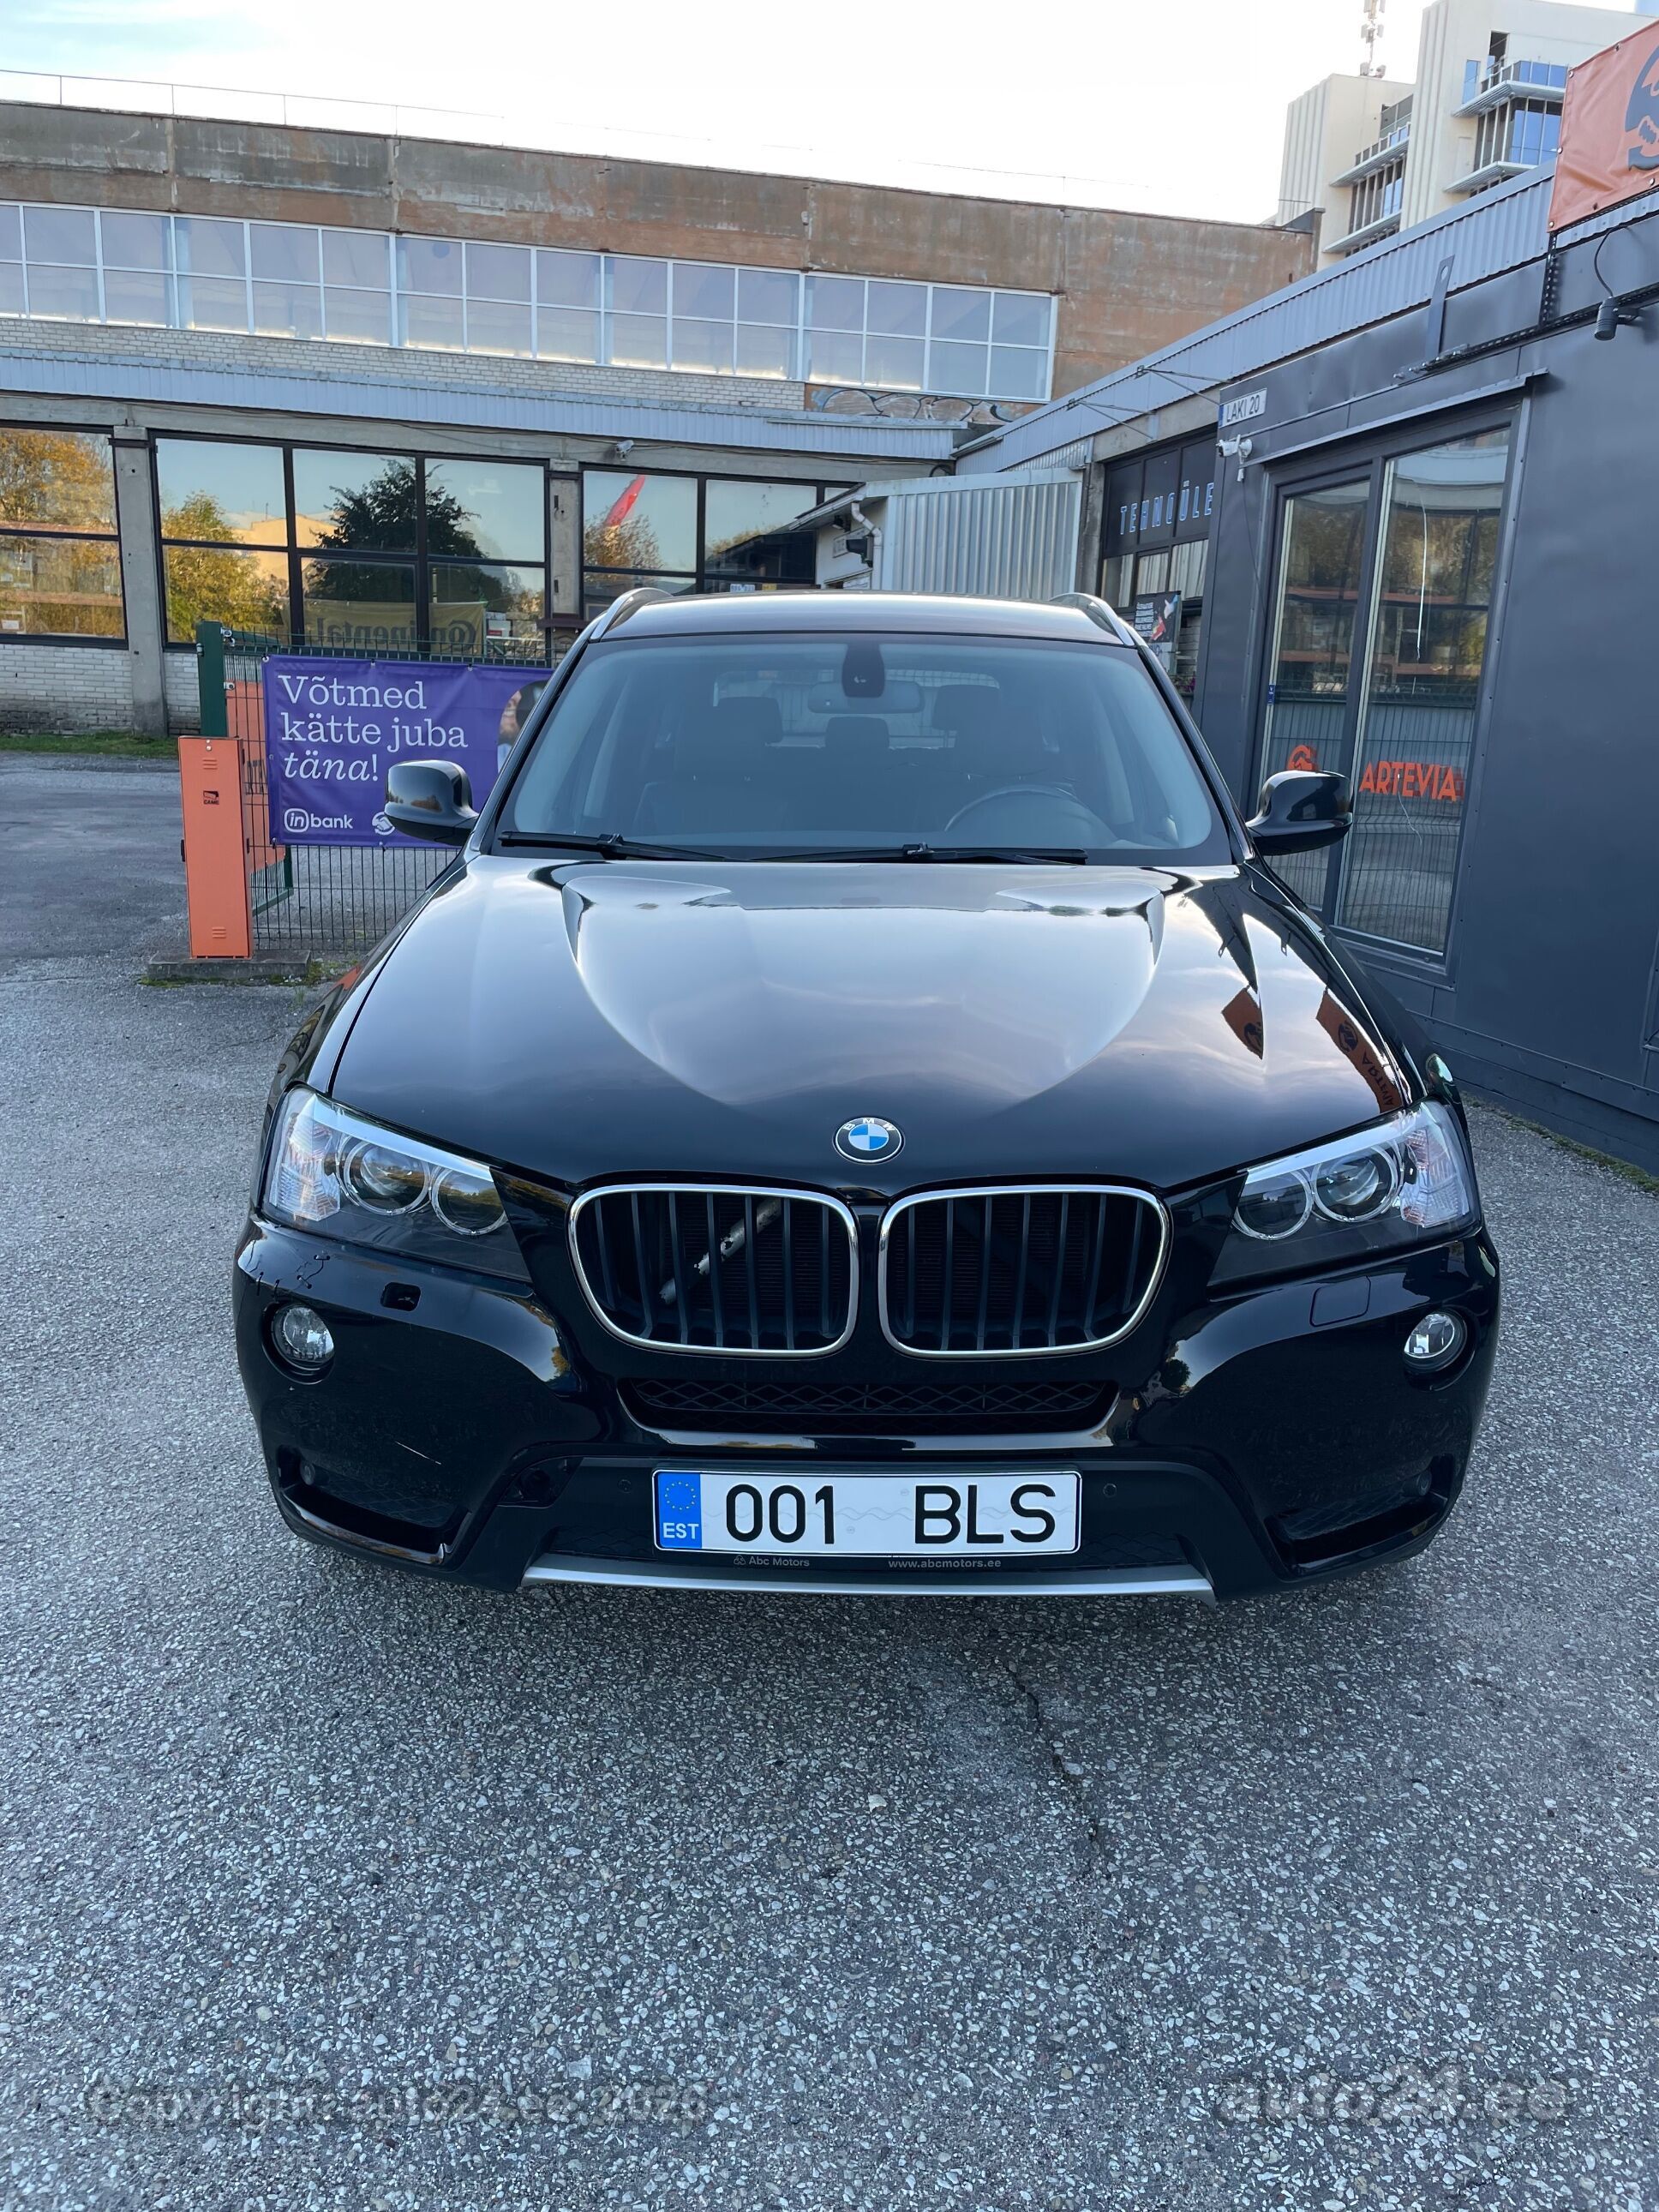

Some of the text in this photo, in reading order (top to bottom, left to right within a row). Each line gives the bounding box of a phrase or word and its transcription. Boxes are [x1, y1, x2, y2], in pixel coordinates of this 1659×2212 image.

[1226, 394, 1260, 423] LAKI 20
[278, 674, 427, 710] Võtmed
[281, 712, 469, 752] kätte juba
[284, 750, 378, 782] täna!
[1358, 761, 1457, 802] ARTEVIA
[726, 1484, 1056, 1544] 001 BLS
[662, 1522, 699, 1539] EST
[749, 1556, 810, 1567] Abc Motors
[888, 1558, 1002, 1568] www.abcmotors.ee
